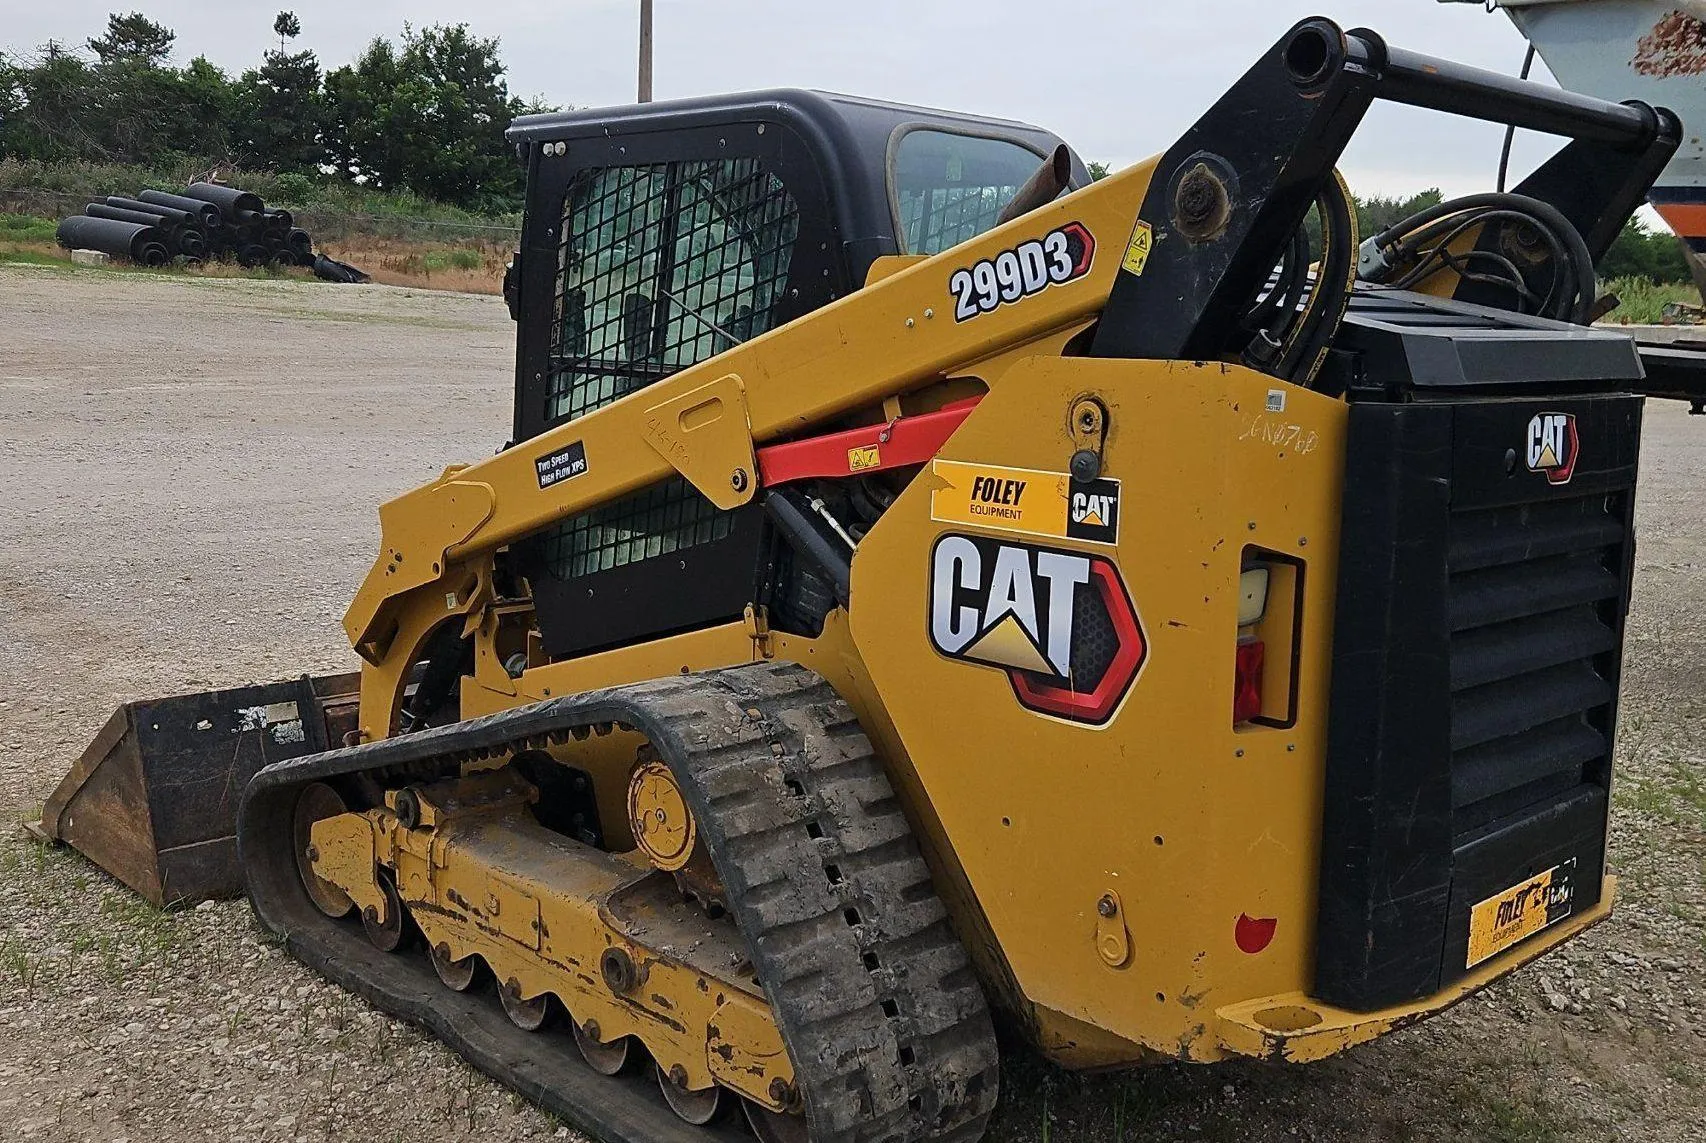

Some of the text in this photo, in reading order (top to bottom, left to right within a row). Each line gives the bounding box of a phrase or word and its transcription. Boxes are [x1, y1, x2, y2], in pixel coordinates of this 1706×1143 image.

[951, 231, 1073, 319] 299D3
[1527, 415, 1567, 468] CAT
[571, 458, 585, 474] XPS
[971, 476, 1027, 506] FOLEY
[970, 504, 1023, 520] EQUIPMENT
[1072, 492, 1116, 527] CAT
[932, 536, 1090, 678] CAT
